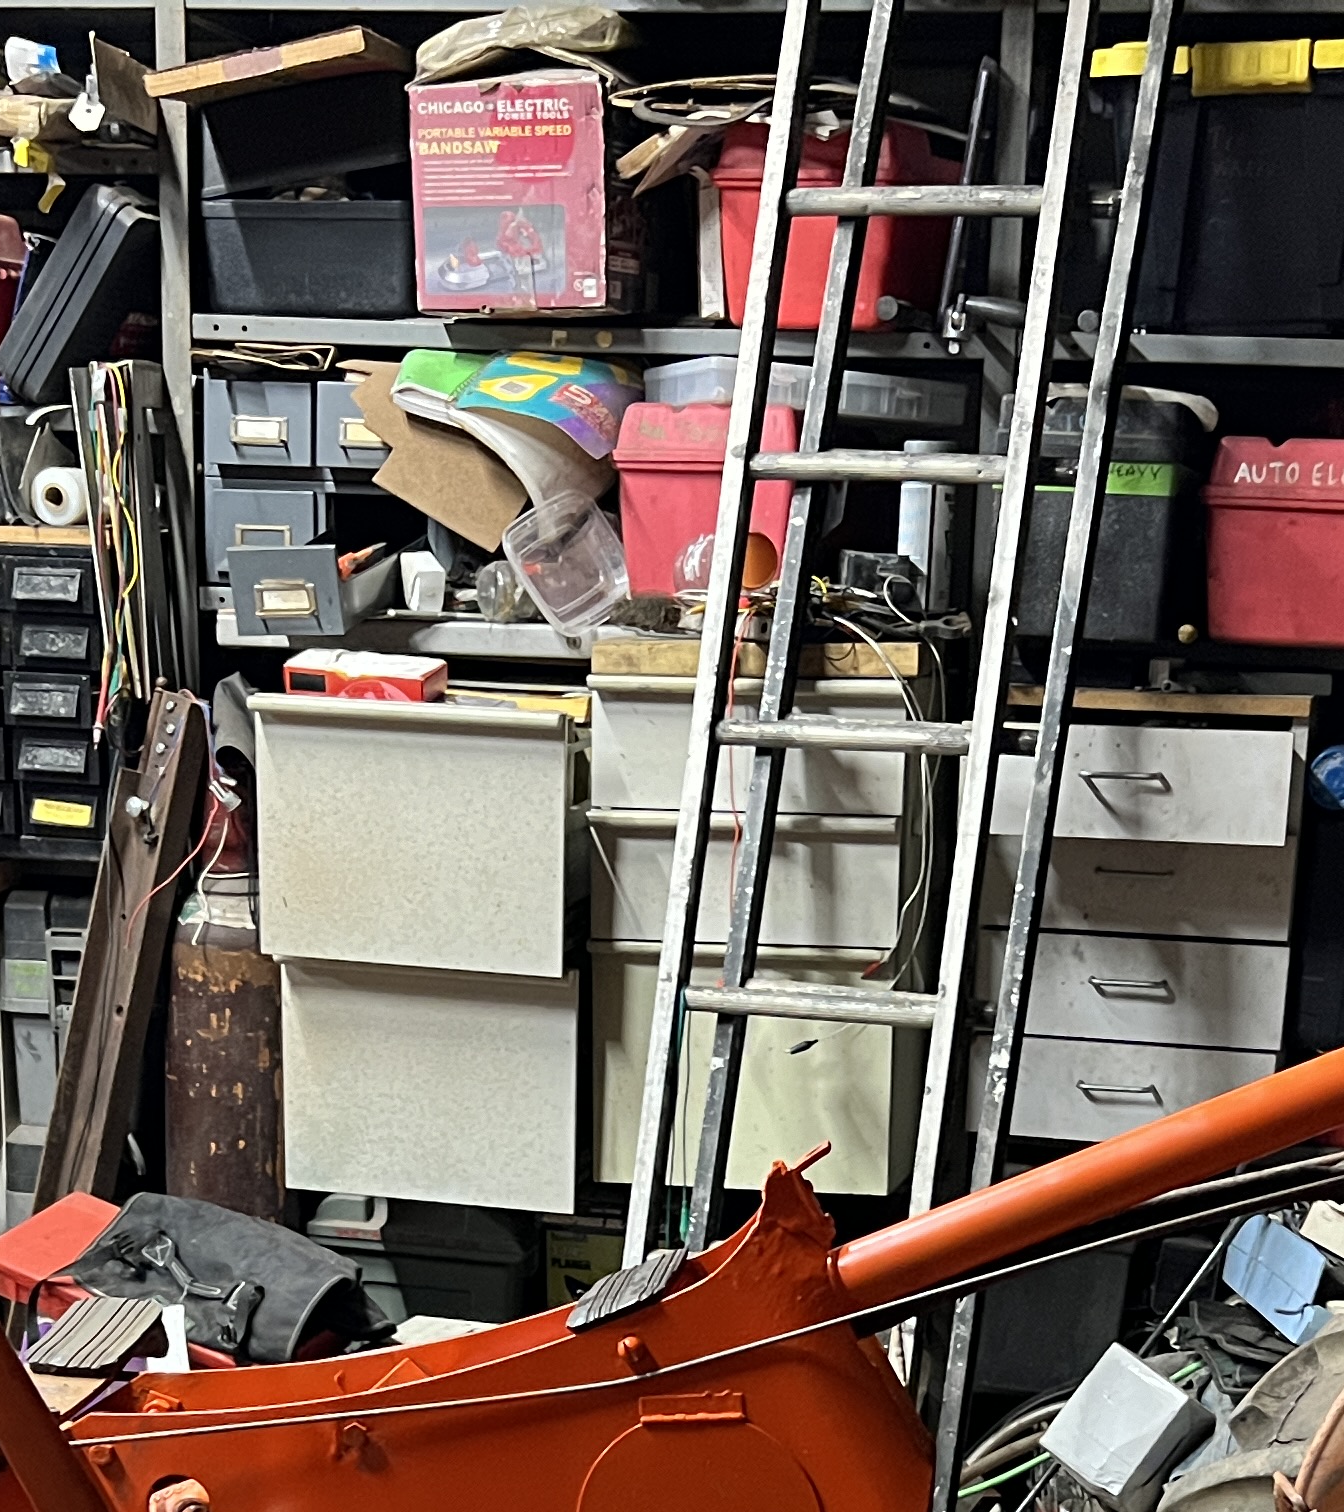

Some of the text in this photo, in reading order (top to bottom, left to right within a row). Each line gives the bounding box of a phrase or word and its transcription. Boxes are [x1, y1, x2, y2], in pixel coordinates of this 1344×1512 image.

[417, 97, 570, 115] CHICAGO ELECTRIC
[497, 111, 570, 121] POWER TOOLS
[417, 124, 572, 139] PORTABLE VARIABLE SPEED
[417, 140, 501, 156] BANDSAW
[1232, 460, 1301, 485] AUTO
